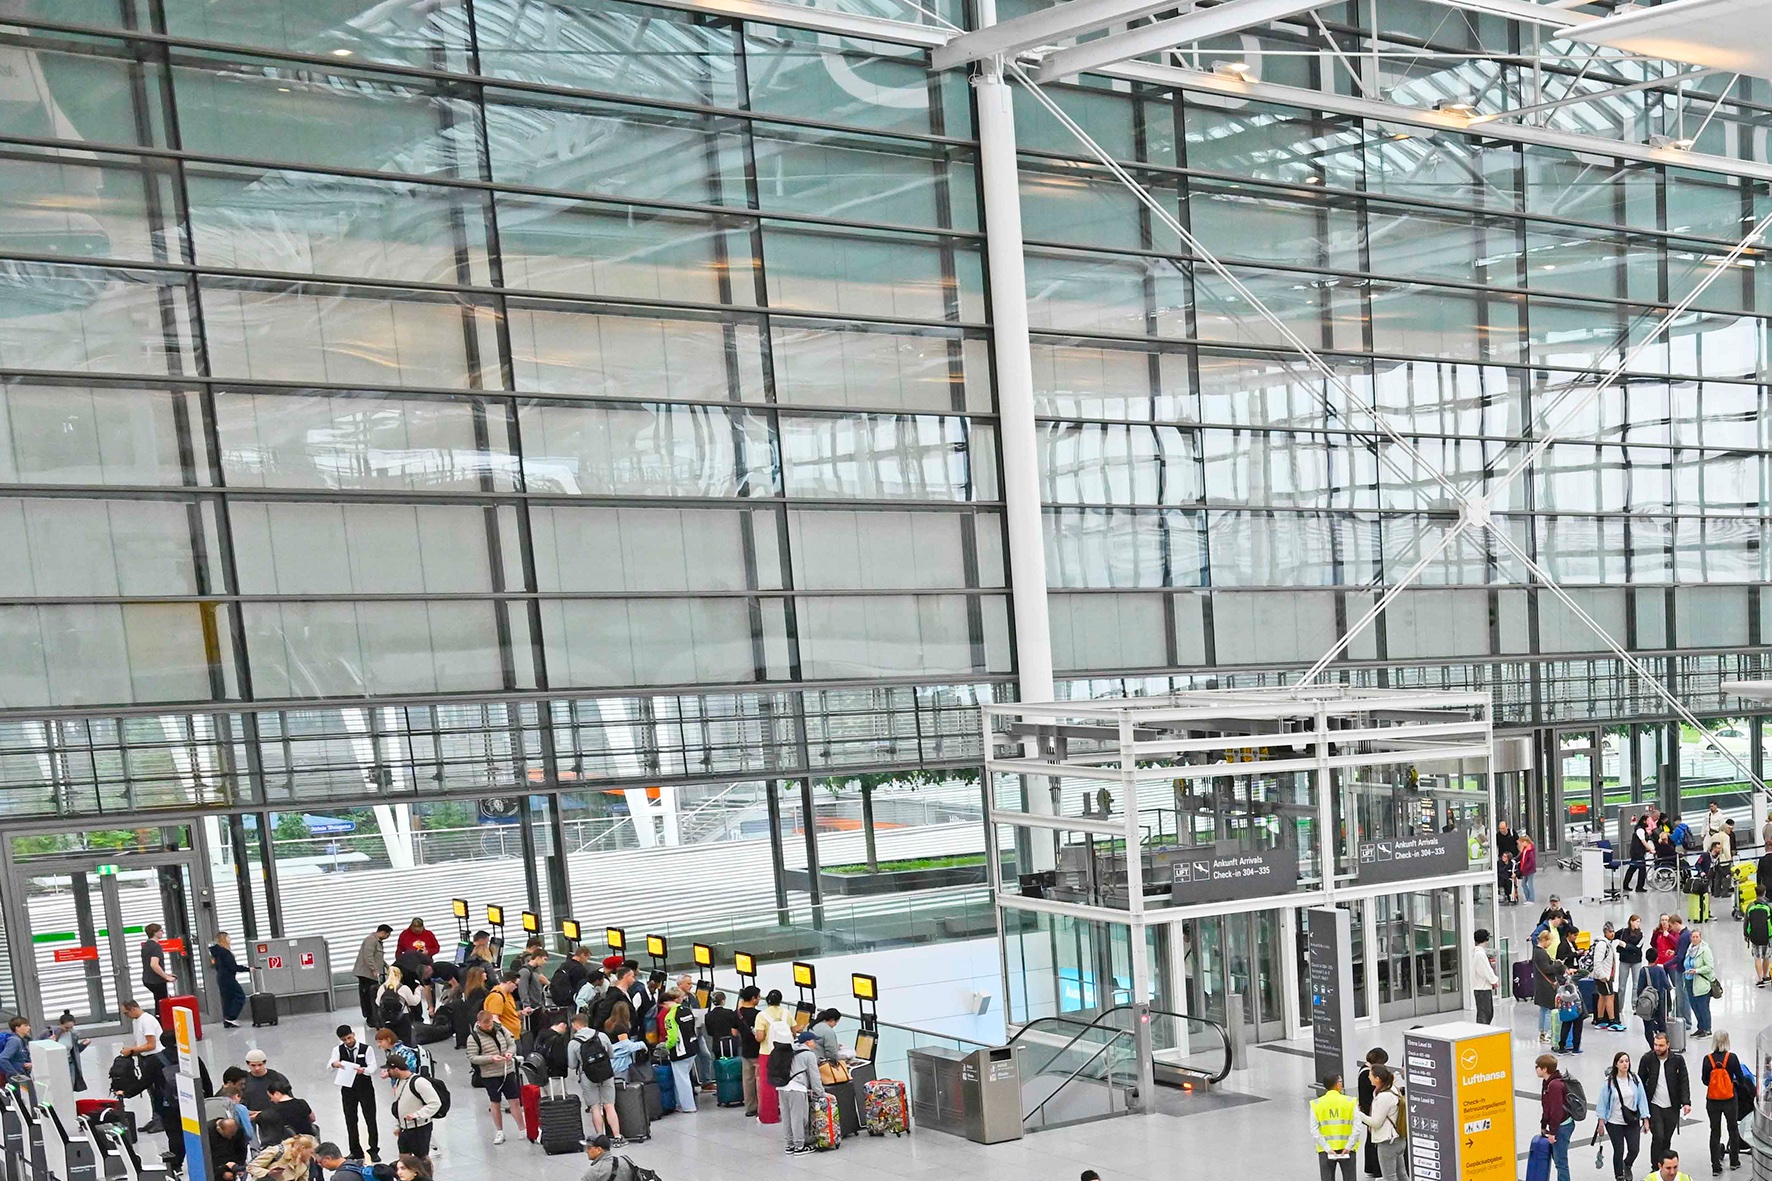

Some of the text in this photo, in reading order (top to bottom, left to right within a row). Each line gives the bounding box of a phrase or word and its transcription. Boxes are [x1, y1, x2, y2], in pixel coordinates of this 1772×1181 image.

[1394, 838, 1439, 849] Ankunft Arrivals
[1394, 850, 1420, 860] Check-in
[1213, 856, 1263, 868] Ankunft Arrivals
[1174, 868, 1189, 877] LIFT
[1213, 869, 1242, 880] Check-in
[1462, 1070, 1506, 1086] Lufthansa
[1463, 1098, 1486, 1107] Check-in
[1464, 1100, 1506, 1114] Betreuungsdienst
[1466, 1156, 1503, 1168] Gepäckabgabe
